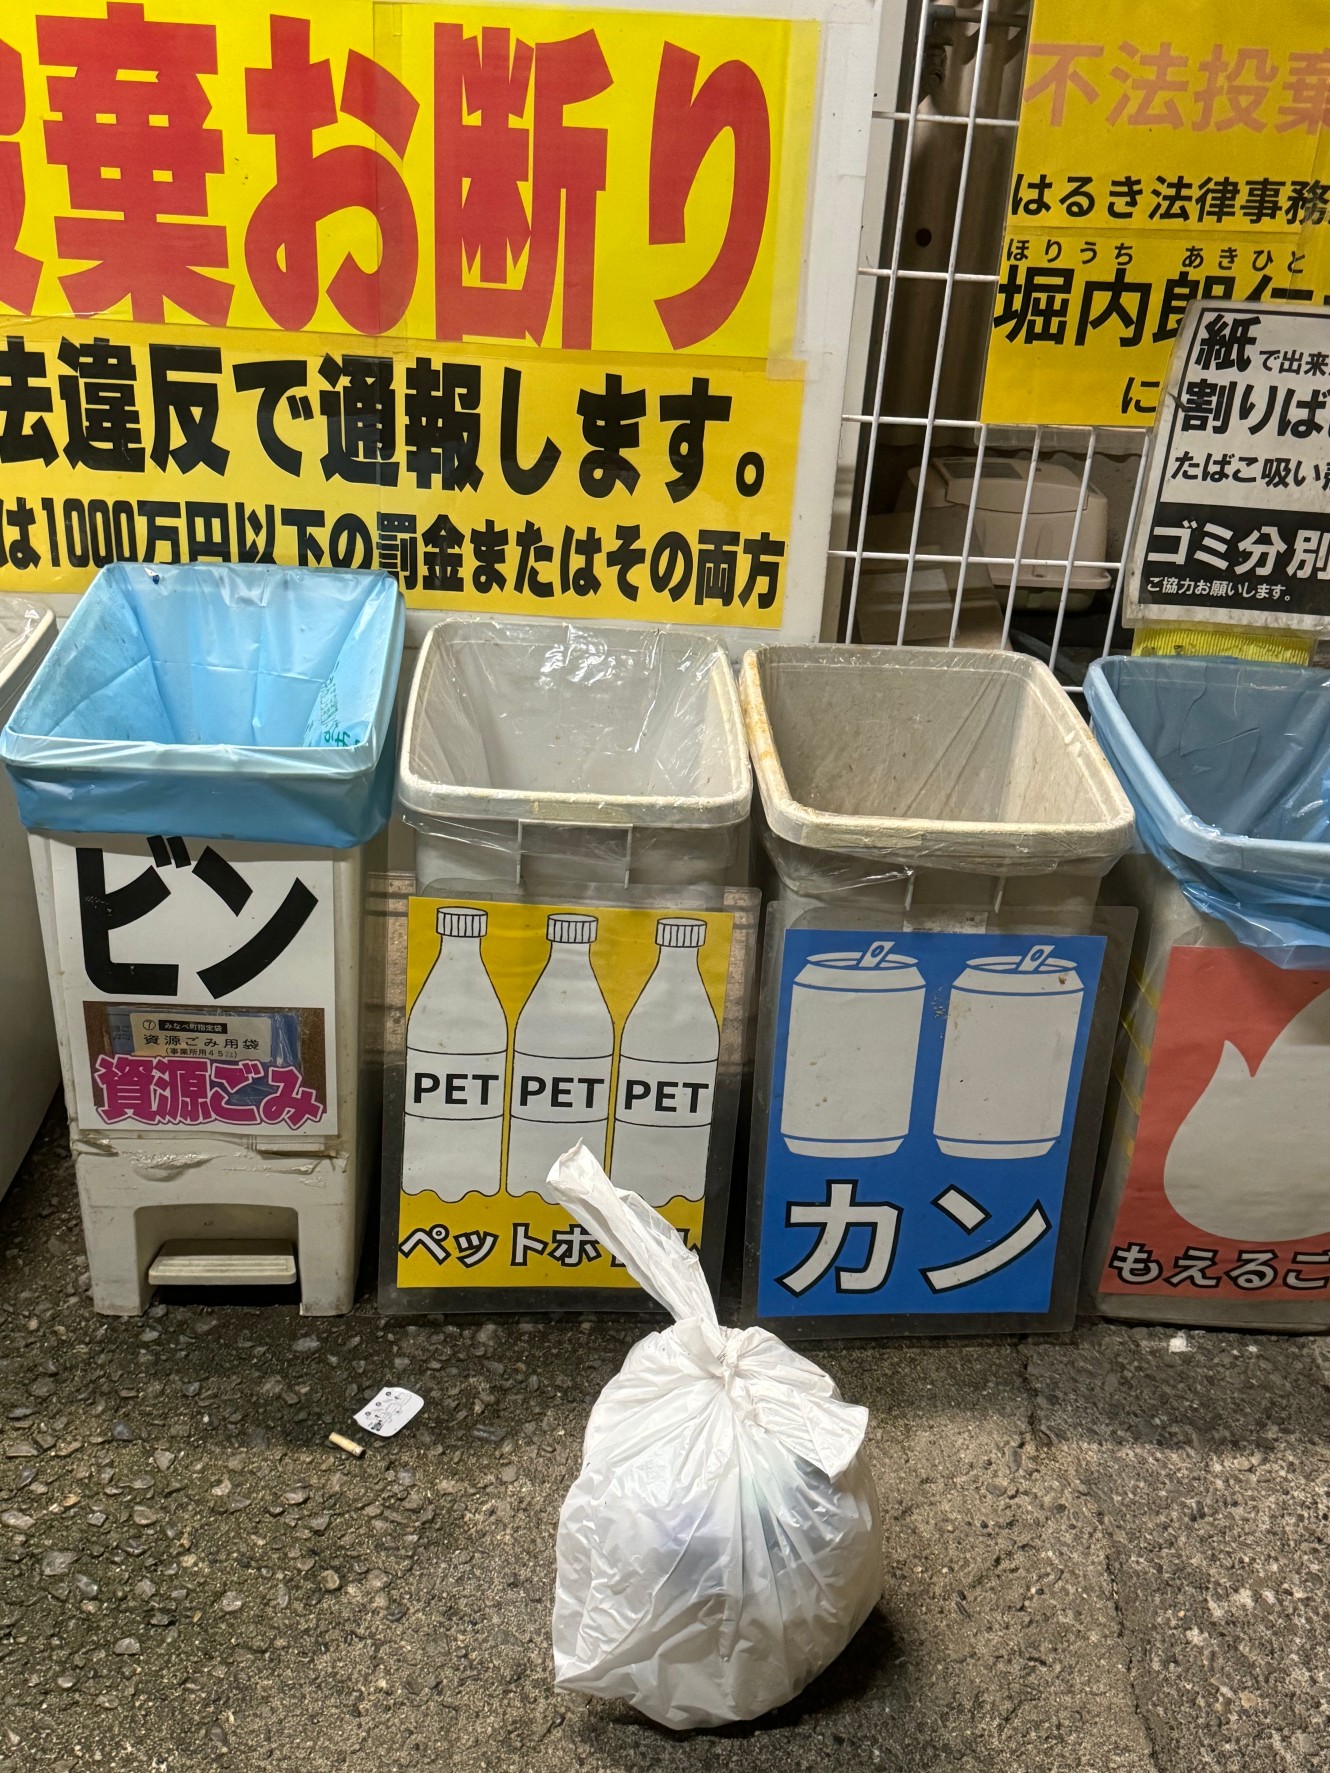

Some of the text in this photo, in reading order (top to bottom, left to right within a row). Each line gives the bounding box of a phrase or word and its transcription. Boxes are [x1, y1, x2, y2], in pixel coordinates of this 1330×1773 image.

[0, 2, 771, 351] 棄お断り
[1011, 173, 1330, 226] はるき法律事務
[1006, 238, 1306, 274] ほりうち あきひと
[1194, 313, 1330, 376] 紙で出来
[1180, 377, 1330, 439] 割りば
[1170, 450, 1330, 492] たばこ吸い
[1147, 519, 1330, 581] ゴミ分別
[1146, 576, 1291, 602] ご協力お願いします。
[75, 834, 319, 999] ビン
[94, 1054, 326, 1130] 資源ごみ
[413, 1072, 709, 1114] PET PET PET
[774, 1179, 1053, 1298] カン
